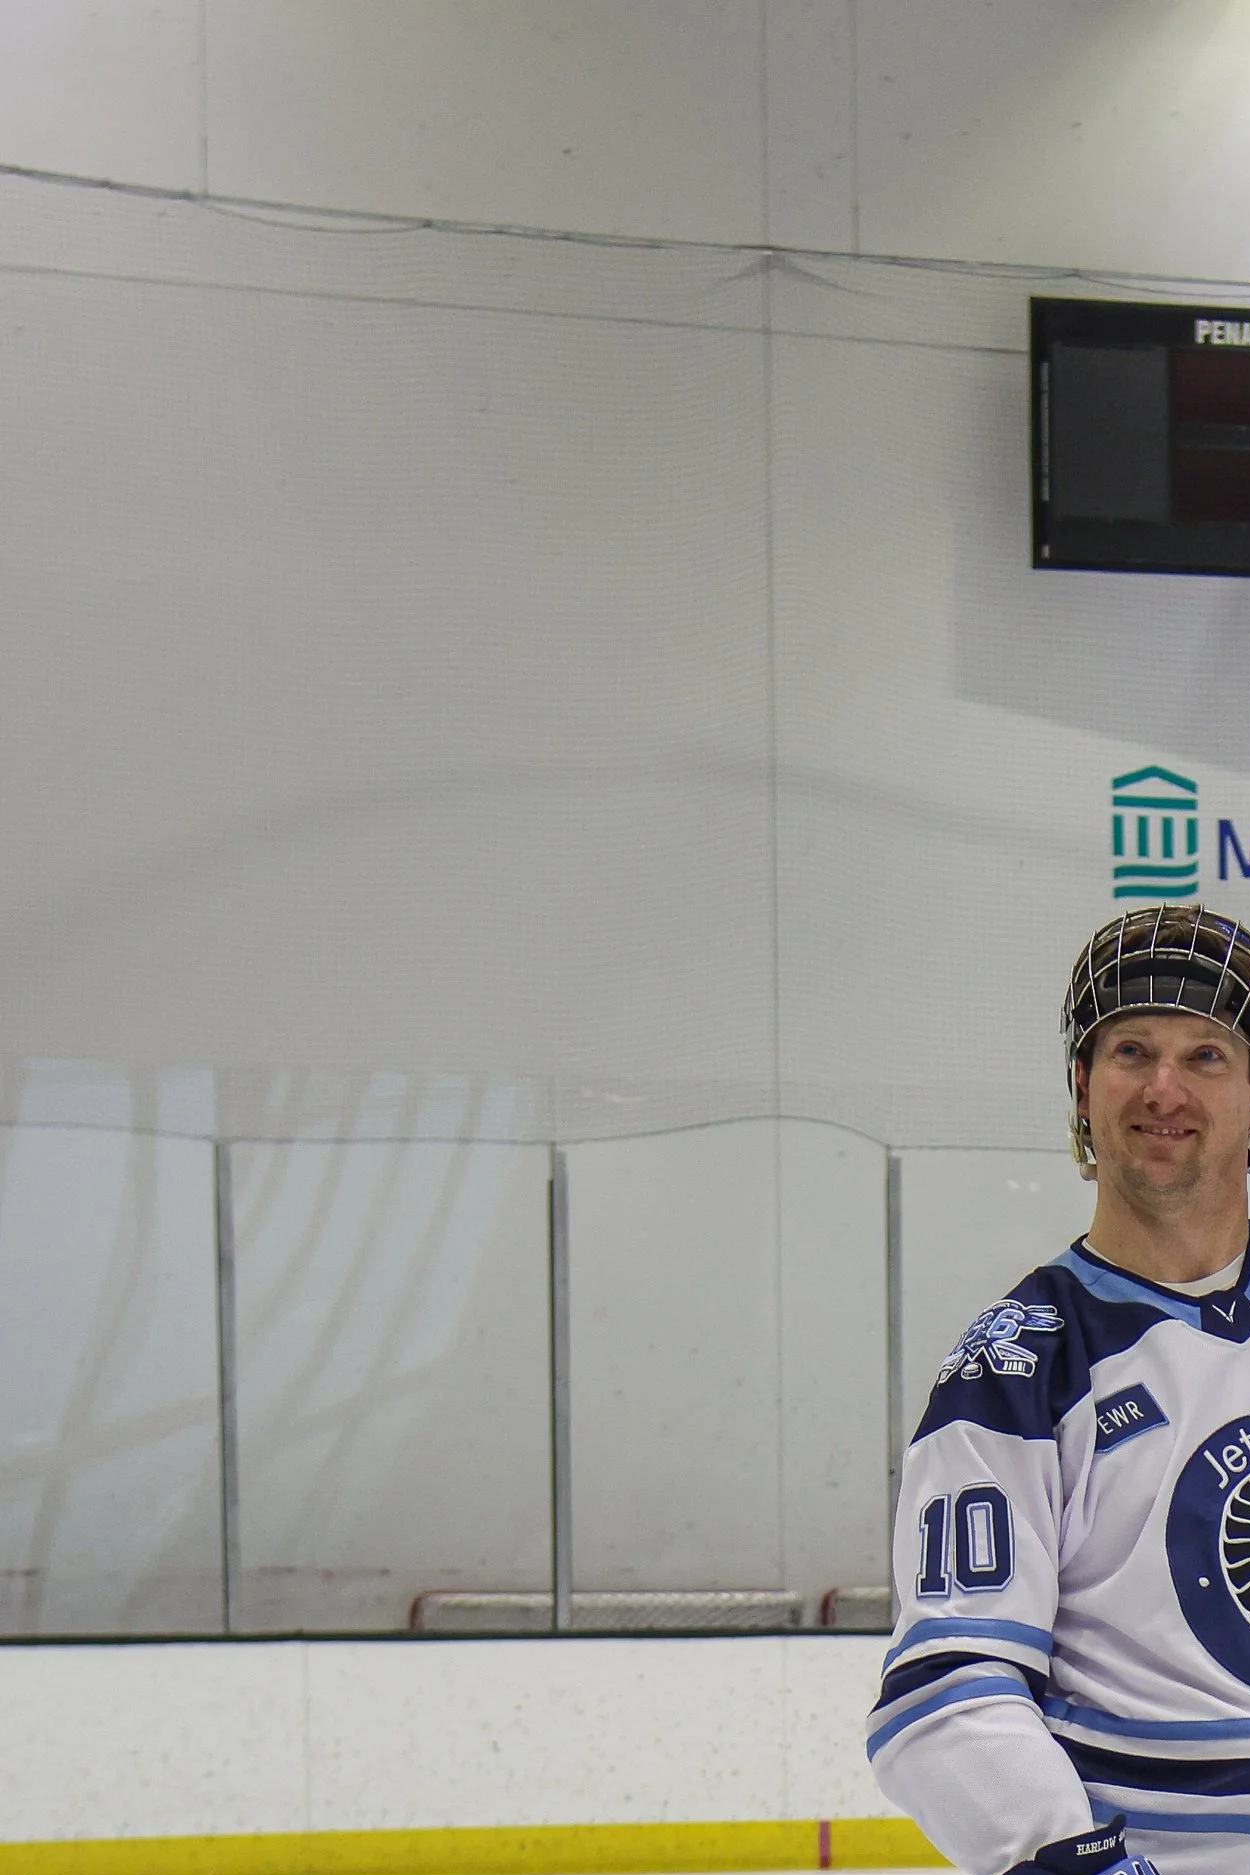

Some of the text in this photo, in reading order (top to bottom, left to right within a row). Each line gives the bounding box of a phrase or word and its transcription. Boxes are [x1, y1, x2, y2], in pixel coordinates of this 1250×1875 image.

[1098, 1400, 1144, 1435] EWR
[915, 1481, 1016, 1599] 10
[1076, 1836, 1117, 1856] HARLOW
